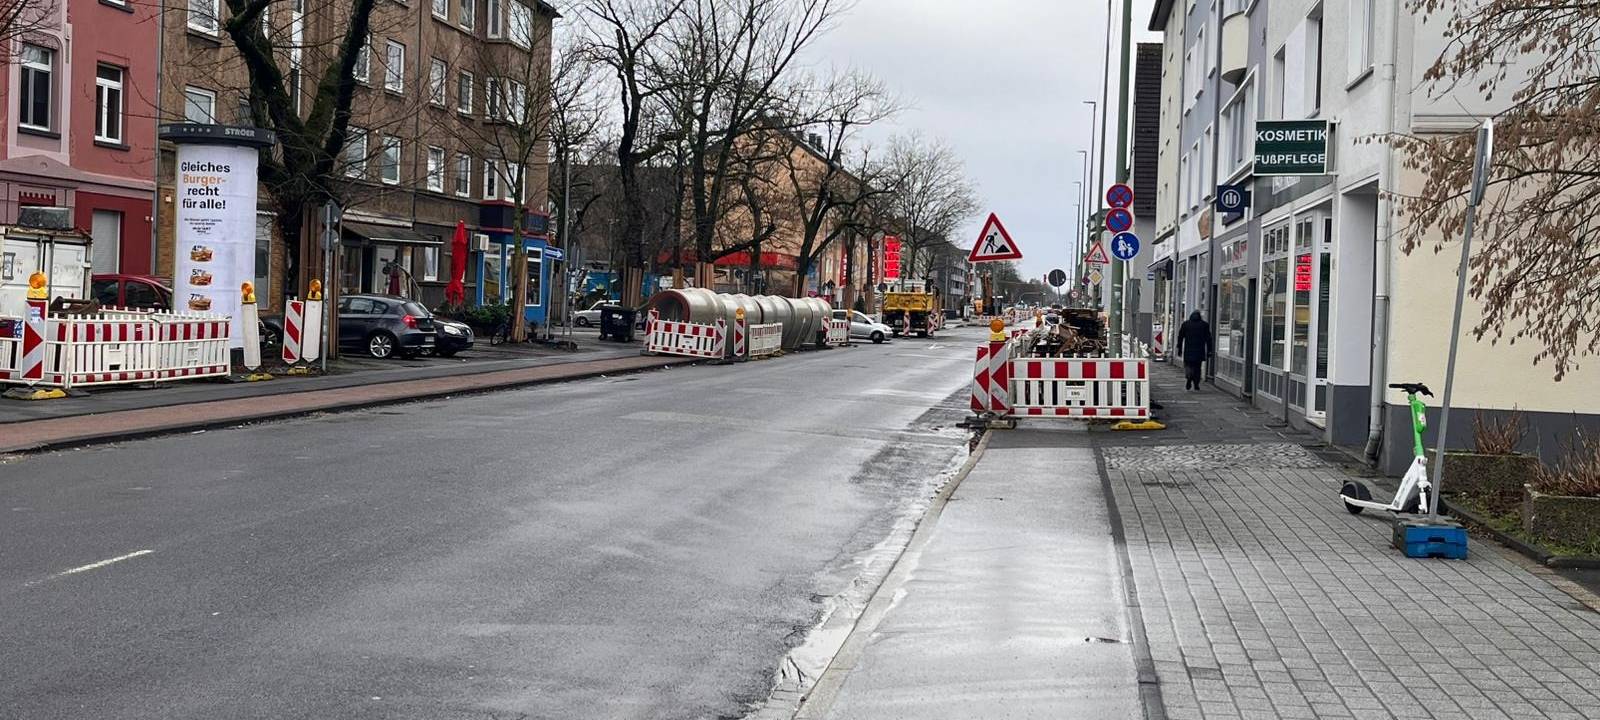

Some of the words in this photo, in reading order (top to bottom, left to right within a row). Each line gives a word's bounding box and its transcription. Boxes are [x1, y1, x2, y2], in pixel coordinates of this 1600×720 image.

[1255, 130, 1326, 141] KOSMETIK
[181, 162, 230, 172] Gleiches
[183, 174, 226, 186] Burger-
[187, 187, 219, 196] recht
[182, 199, 197, 208] für
[199, 199, 226, 209] alle!
